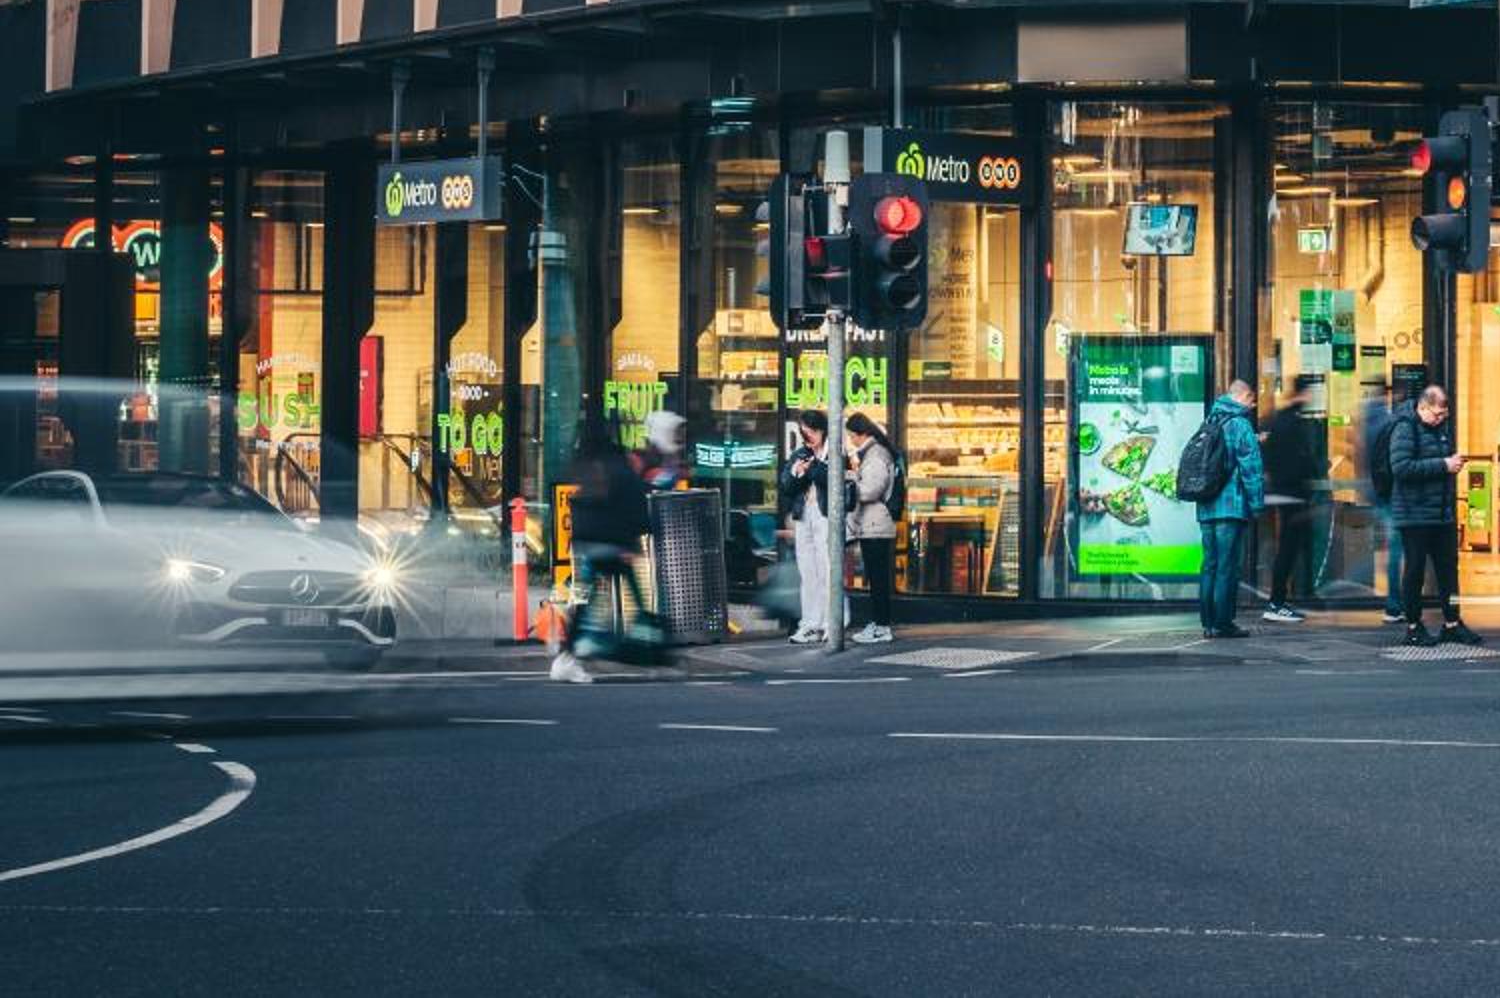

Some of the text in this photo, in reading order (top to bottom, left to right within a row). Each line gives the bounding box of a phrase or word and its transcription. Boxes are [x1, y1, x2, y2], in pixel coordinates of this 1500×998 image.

[926, 154, 970, 183] Metro
[404, 179, 437, 208] Metro
[604, 381, 669, 421] FRUIT
[785, 356, 888, 410] LUCH
[237, 391, 321, 429] SUSH
[437, 412, 503, 457] TO GO
